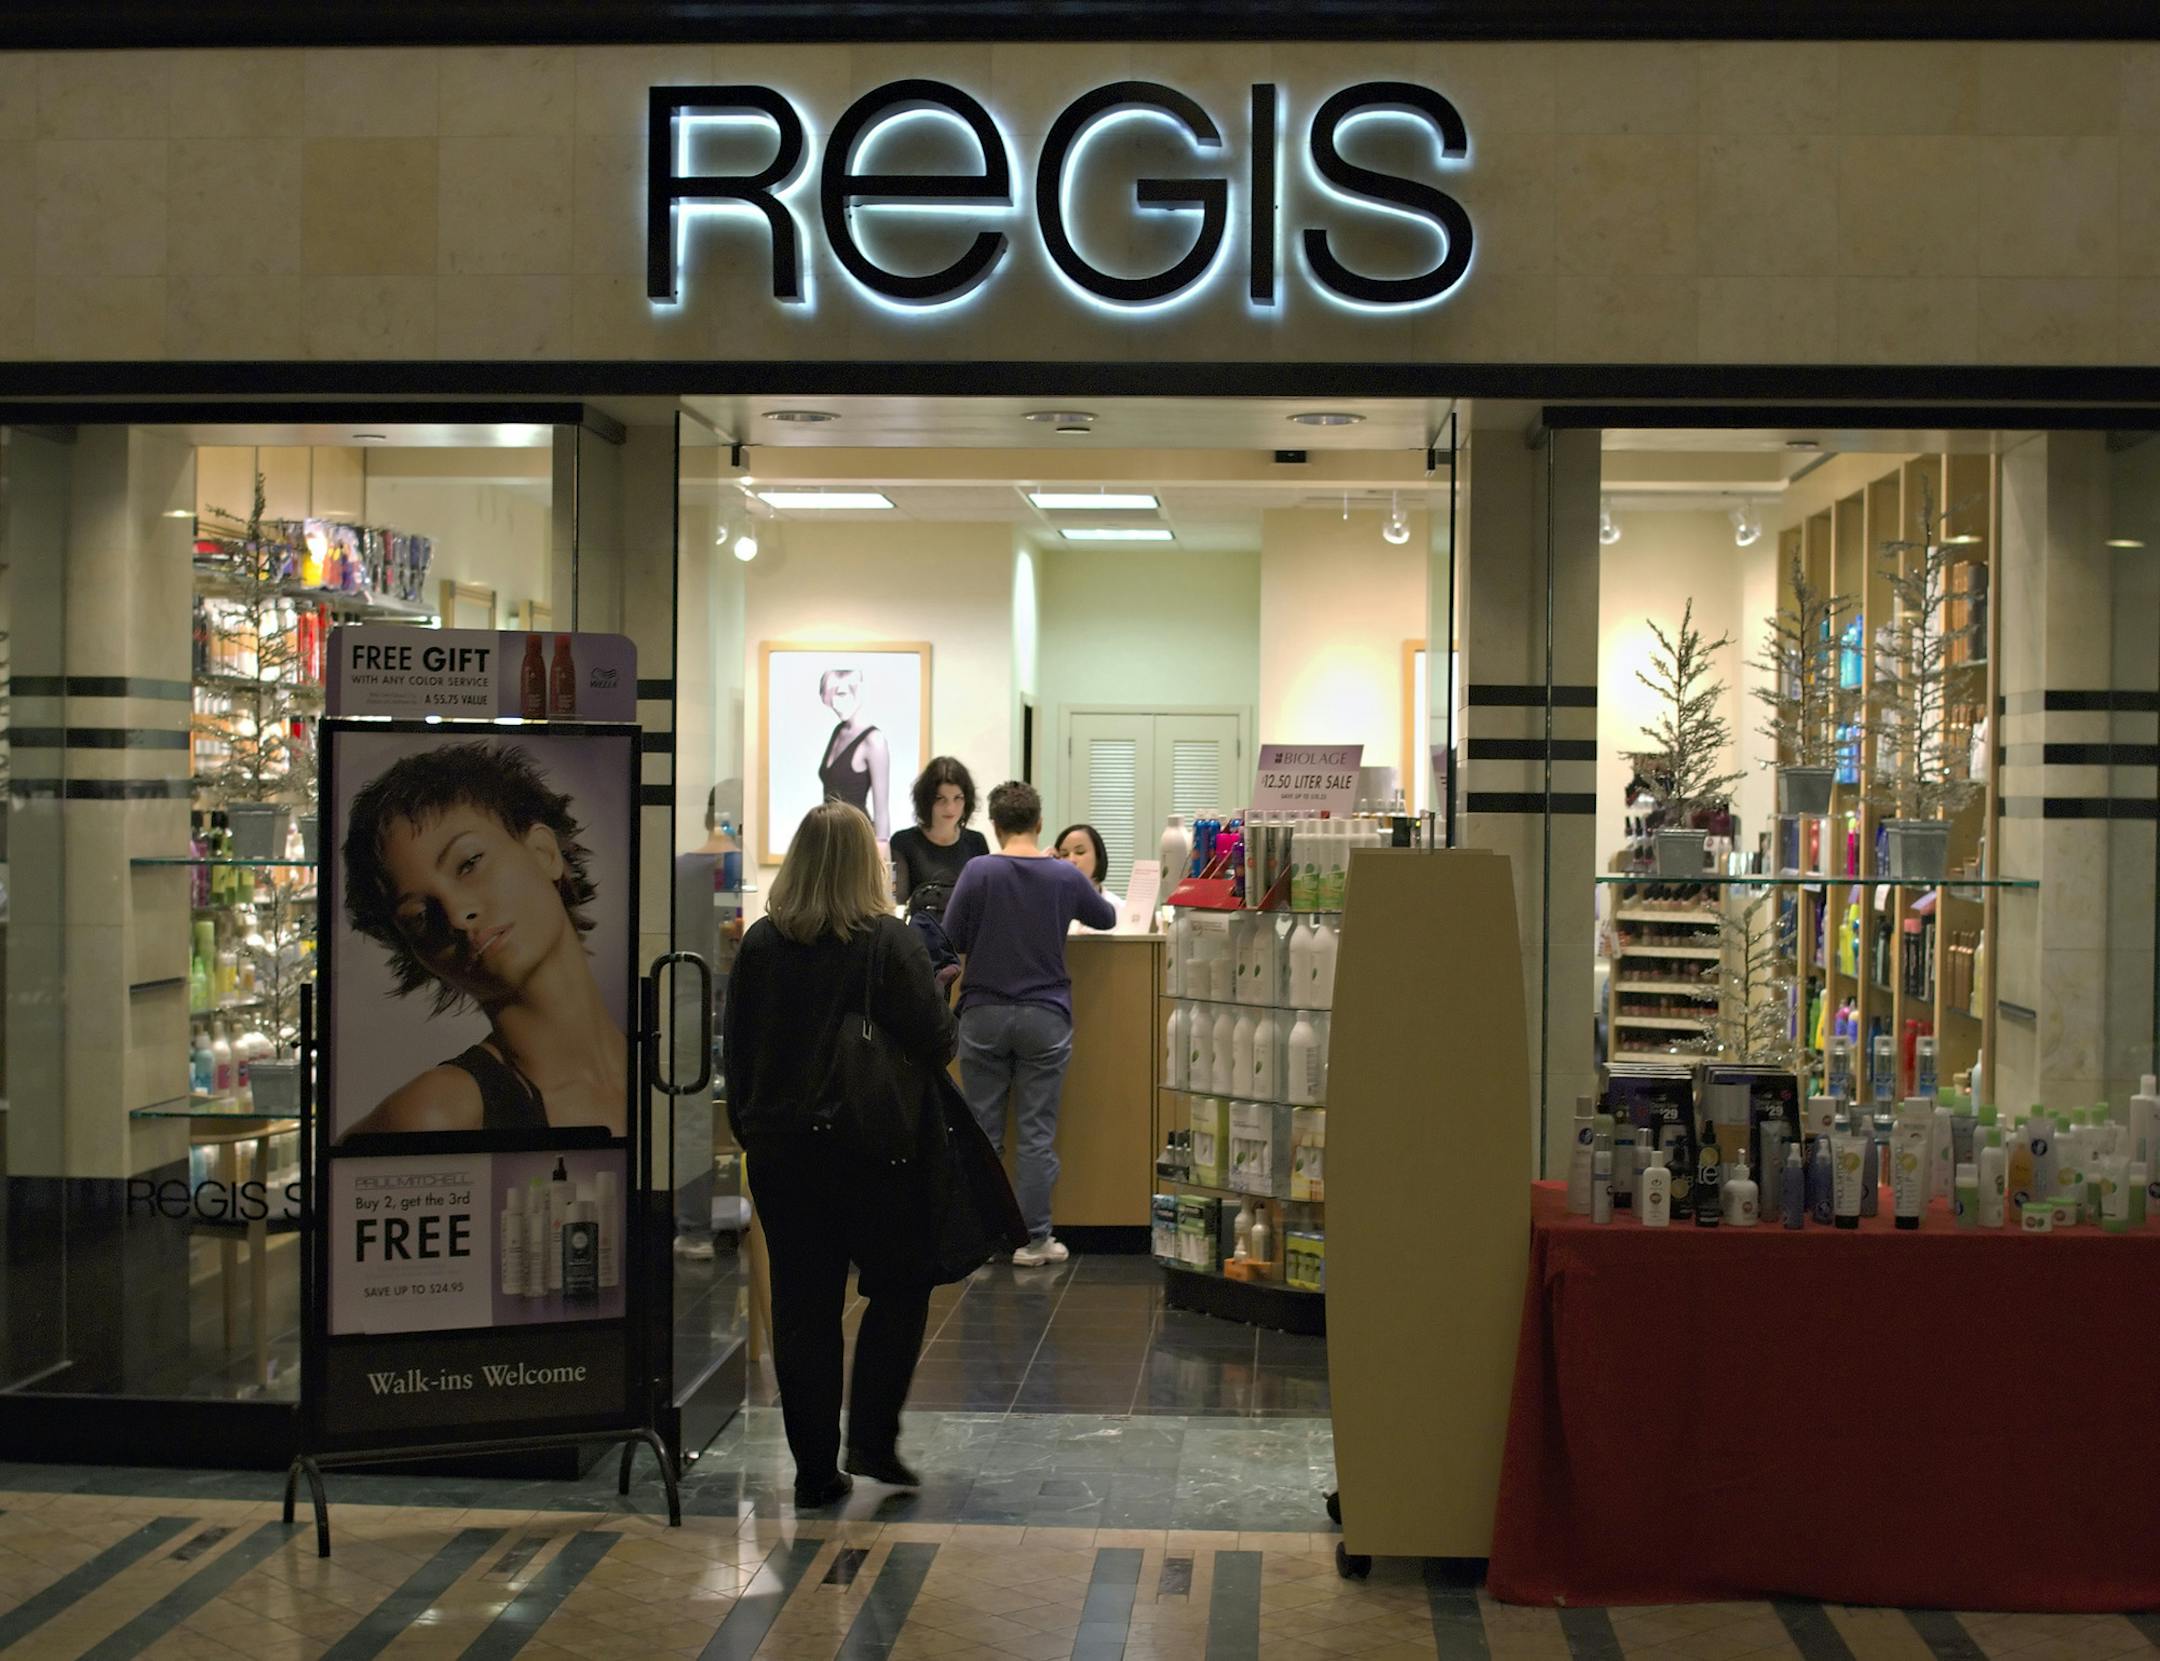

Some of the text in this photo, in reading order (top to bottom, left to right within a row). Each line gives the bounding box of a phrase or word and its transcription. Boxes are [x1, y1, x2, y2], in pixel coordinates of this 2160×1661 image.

[353, 645, 490, 672] FREE GIFT
[352, 675, 489, 687] WITH ANY COLOR SERVICE
[425, 694, 432, 704] A
[461, 694, 488, 705] VALUE
[1283, 752, 1348, 765] BIOLAGE
[1294, 774, 1323, 790] LITER
[1325, 774, 1353, 790] SALE
[355, 1190, 471, 1212] Buy 2, get the 3rd
[356, 1214, 471, 1262] FREE
[364, 1281, 465, 1298] SAVE UP TO $24.95
[366, 1362, 588, 1396] Walk-ins Welcome
